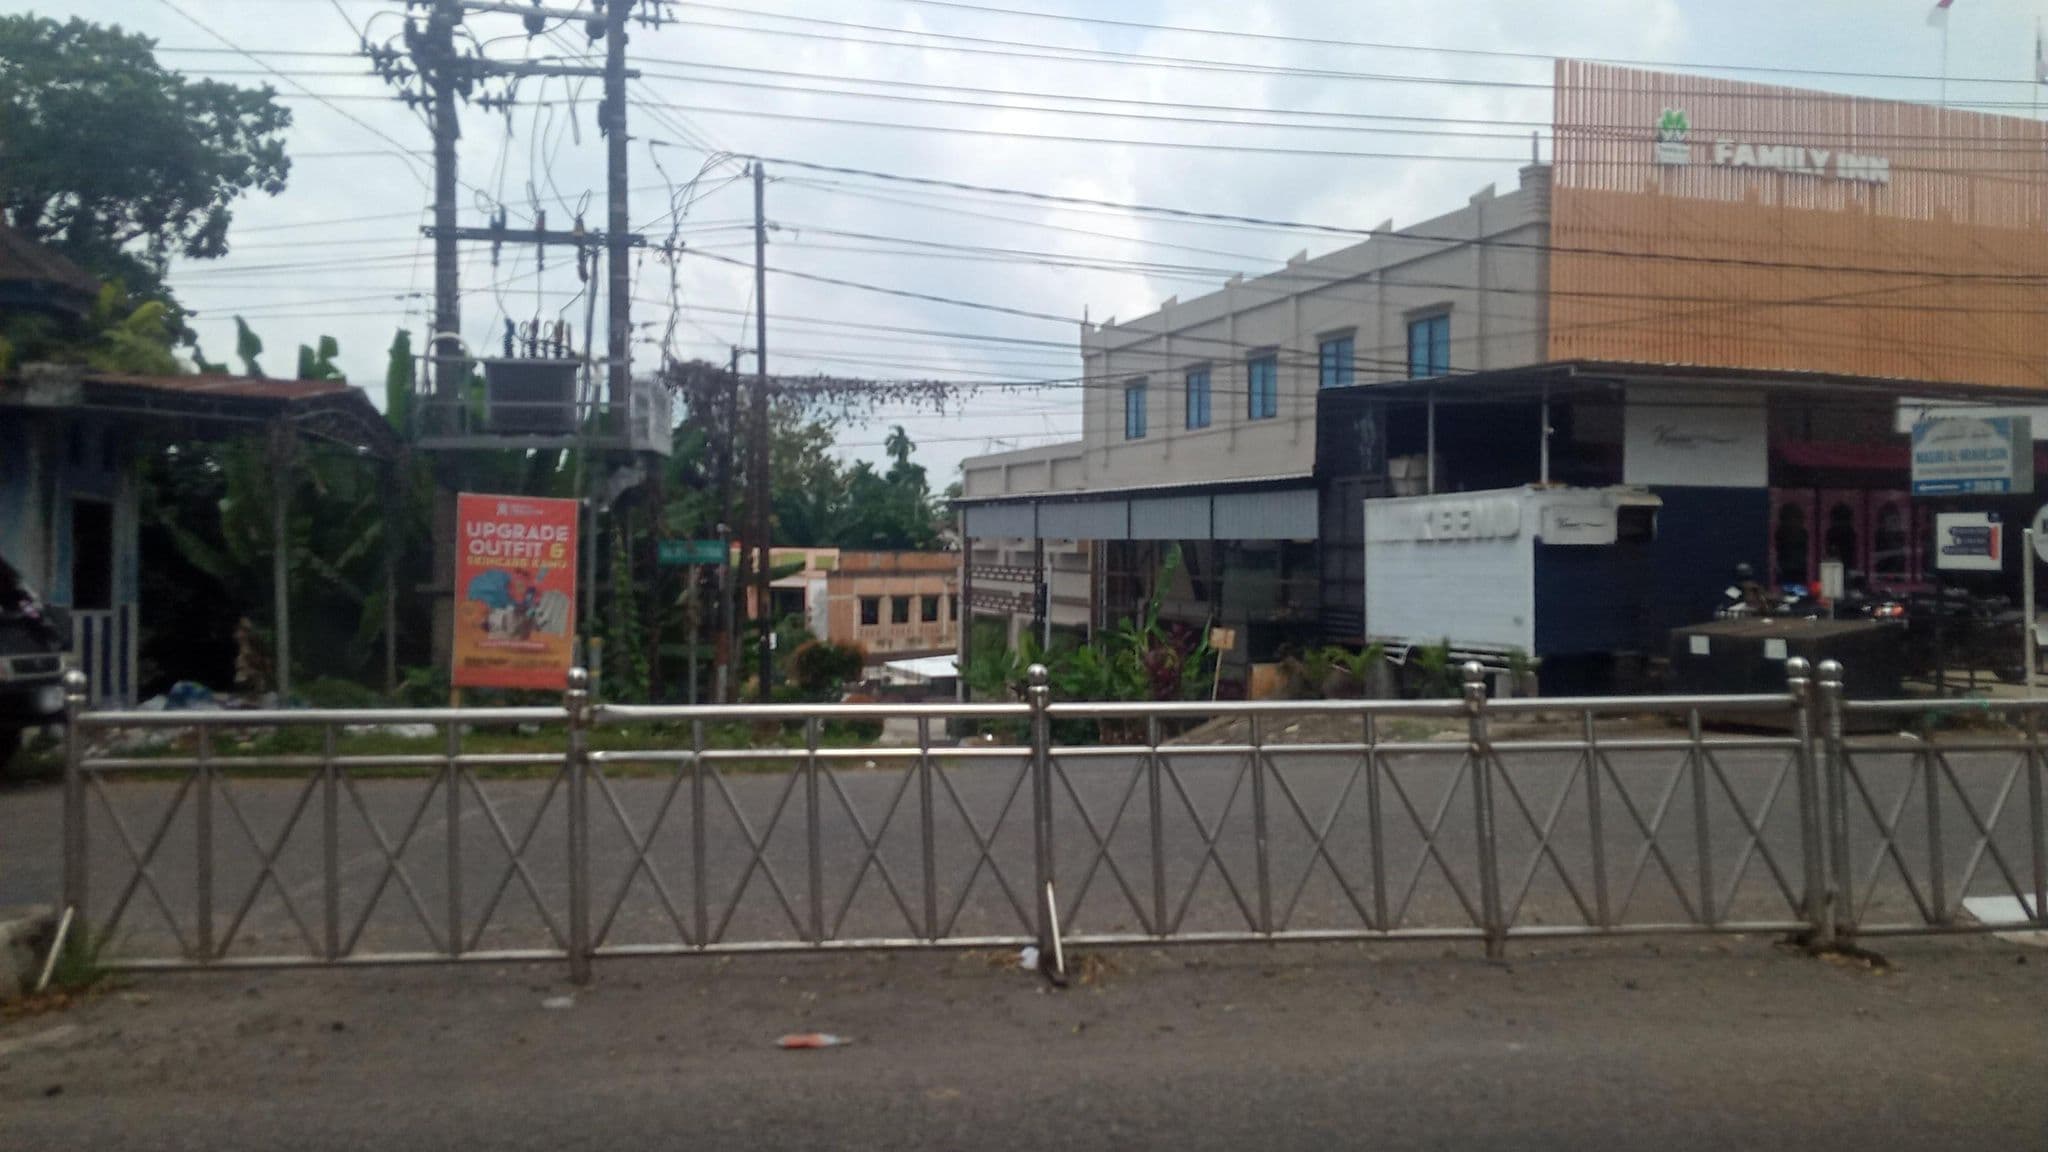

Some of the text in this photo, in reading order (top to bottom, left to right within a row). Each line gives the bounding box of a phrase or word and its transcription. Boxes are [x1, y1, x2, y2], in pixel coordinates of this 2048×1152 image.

[1714, 138, 1831, 176] FAMILY
[466, 521, 569, 542] UPGRADE
[469, 539, 543, 558] OUTFIT
